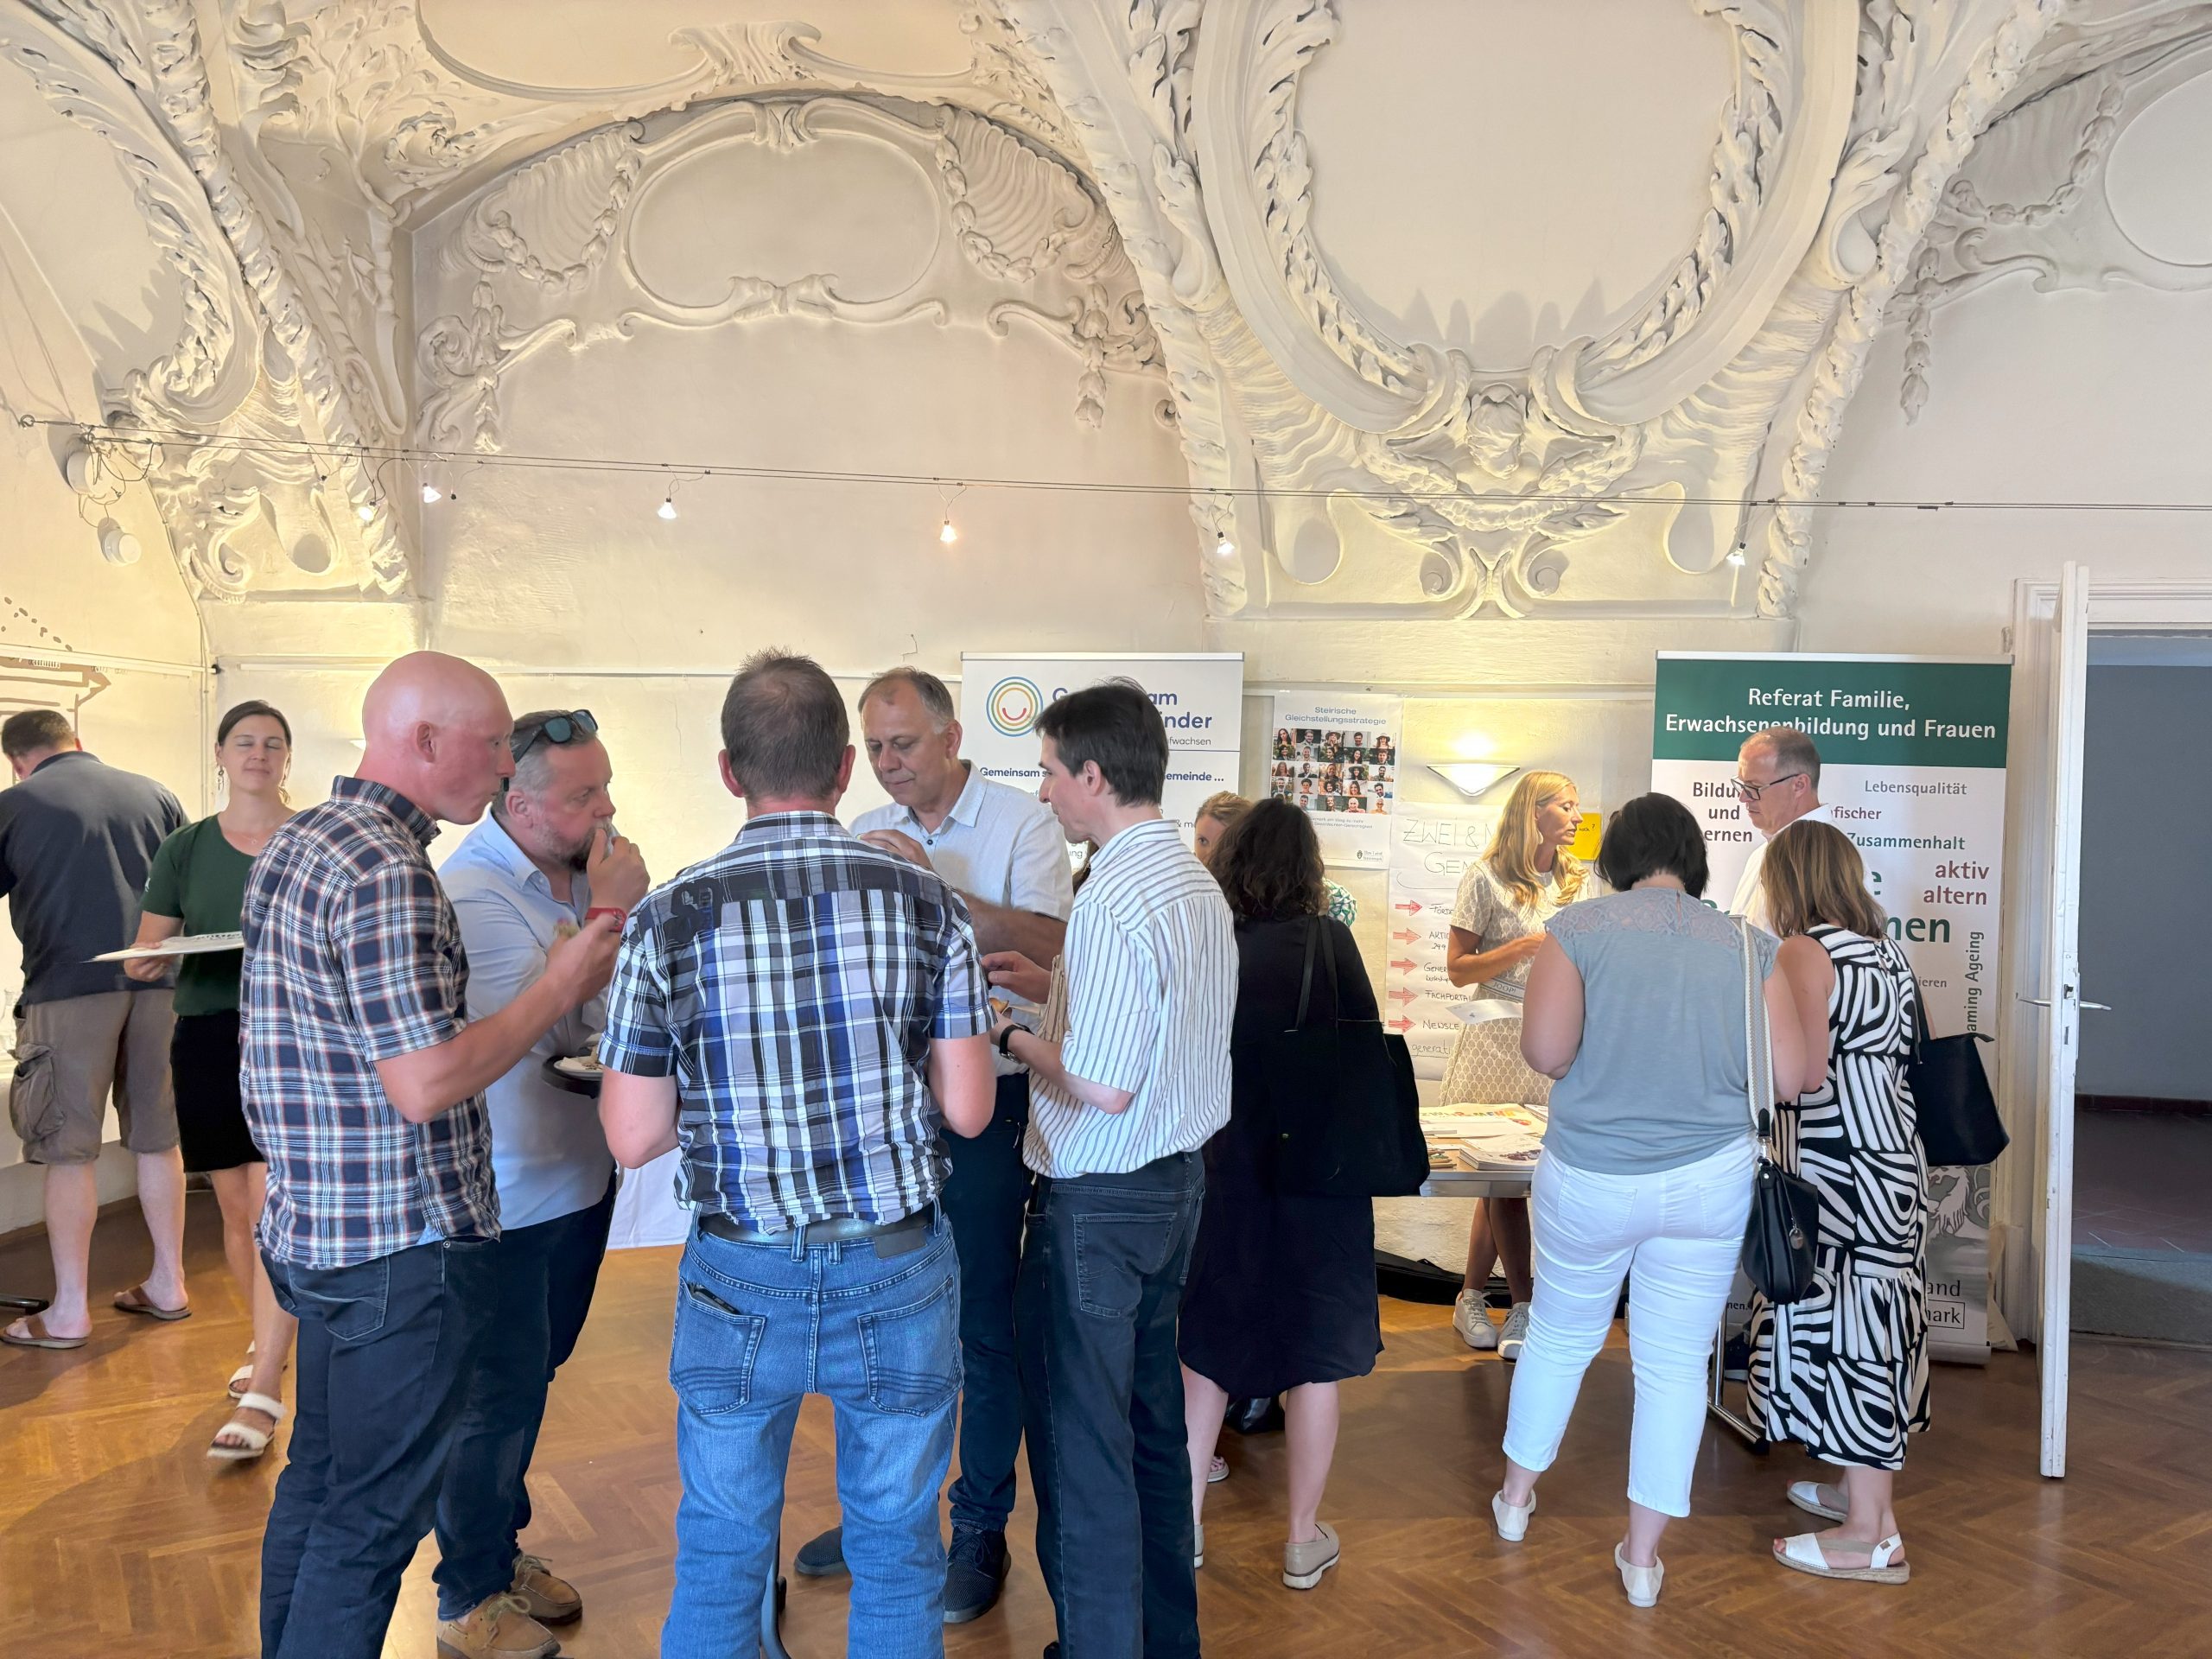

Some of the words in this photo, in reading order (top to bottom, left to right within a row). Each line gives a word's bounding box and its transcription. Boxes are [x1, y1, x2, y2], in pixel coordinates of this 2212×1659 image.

[1748, 688, 1823, 707] Referat
[1830, 690, 1910, 710] Familie,
[1314, 706, 1357, 715] Steirische
[1163, 711, 1212, 729] nder
[1285, 714, 1387, 726] Gleichstellungsstrategie
[1877, 718, 1916, 737] und
[1923, 718, 1997, 739] Frauen
[1168, 735, 1211, 746] fwachsen
[980, 766, 1040, 778] Gemeinsam
[1164, 771, 1212, 781] emeinde
[1693, 781, 1740, 798] Bildu
[1865, 779, 1967, 797] Lebensqualität
[1708, 804, 1740, 820] und
[1831, 805, 1882, 820] fischer
[1403, 817, 1458, 847] ZWEI
[1465, 825, 1479, 849] &
[1704, 830, 1753, 842] ernen
[1935, 860, 1990, 880] aktiv
[1923, 885, 1987, 906] altern
[1964, 931, 1984, 982] Ageing
[1423, 962, 1448, 973] GENER
[1492, 981, 1516, 993] JOOP!
[1918, 976, 1948, 988] ieren
[1963, 988, 1982, 1033] aming
[1422, 1020, 1460, 1031] NEWSLE
[1411, 1039, 1451, 1055] generati
[1927, 1280, 1961, 1297] and
